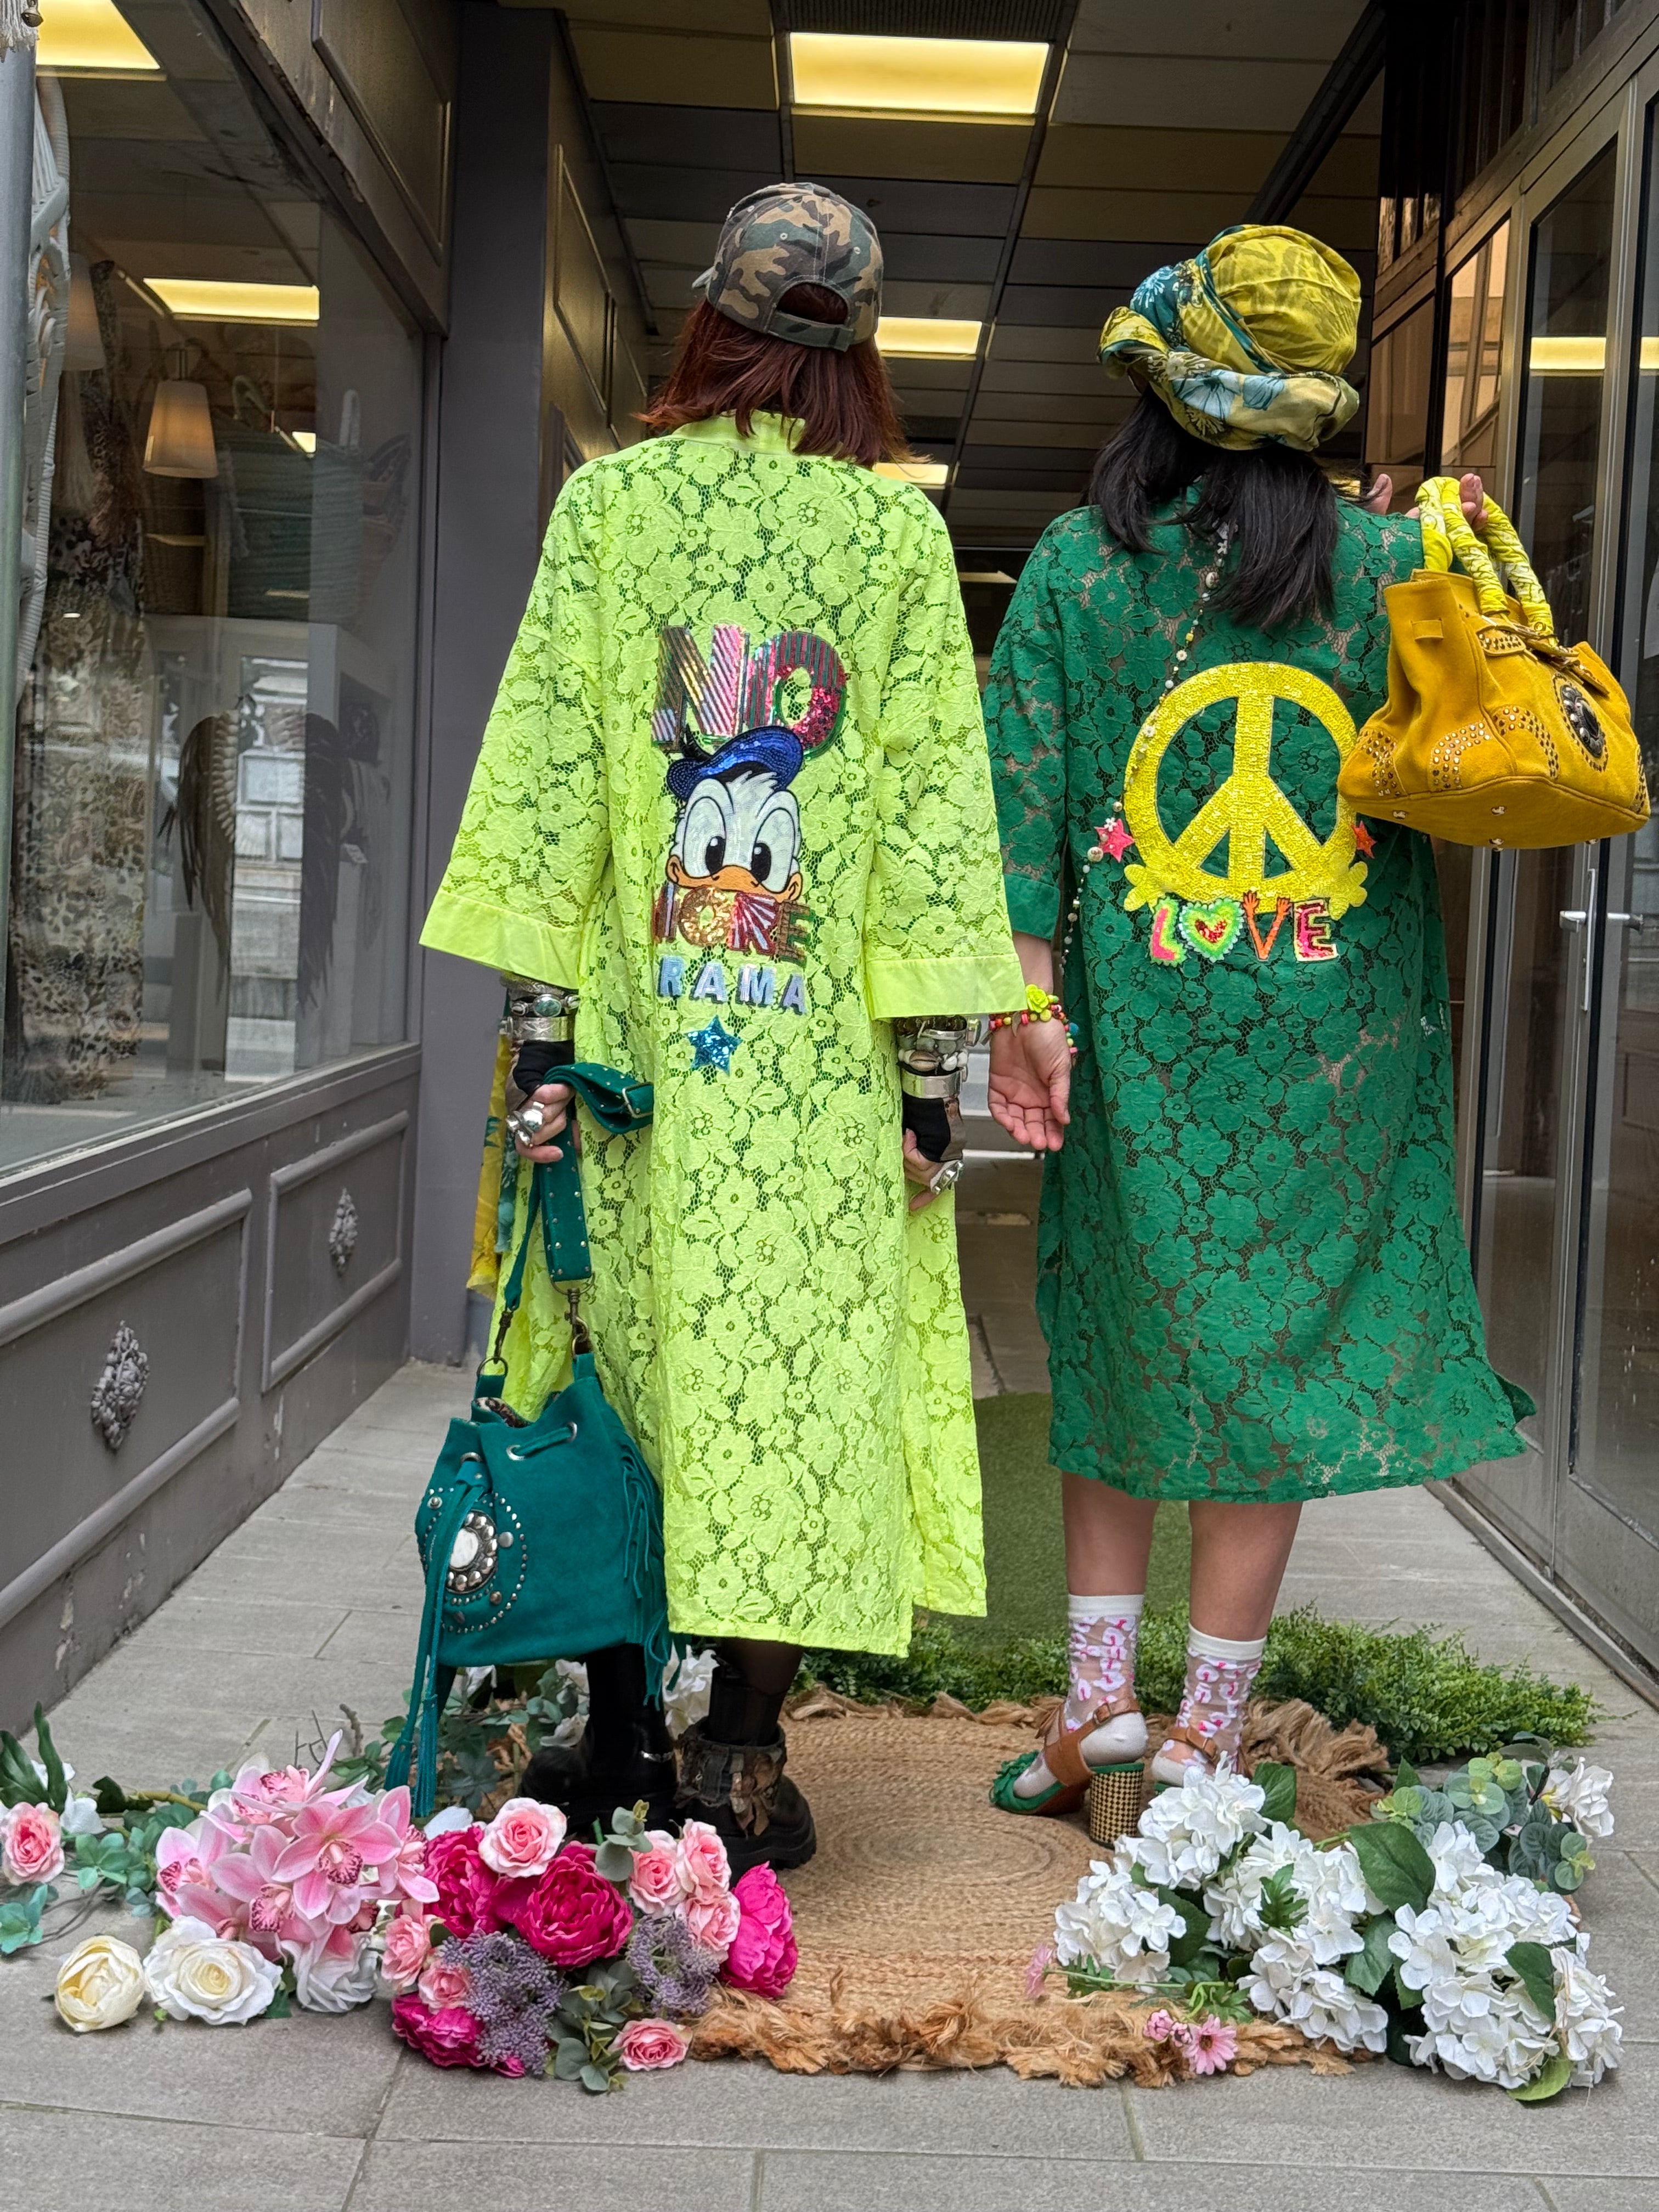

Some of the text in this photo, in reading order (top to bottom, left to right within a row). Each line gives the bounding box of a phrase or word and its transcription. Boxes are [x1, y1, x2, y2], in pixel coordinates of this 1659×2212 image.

[651, 624, 847, 761] NO
[1149, 890, 1339, 967] LOVE
[657, 955, 808, 1015] RAMA
